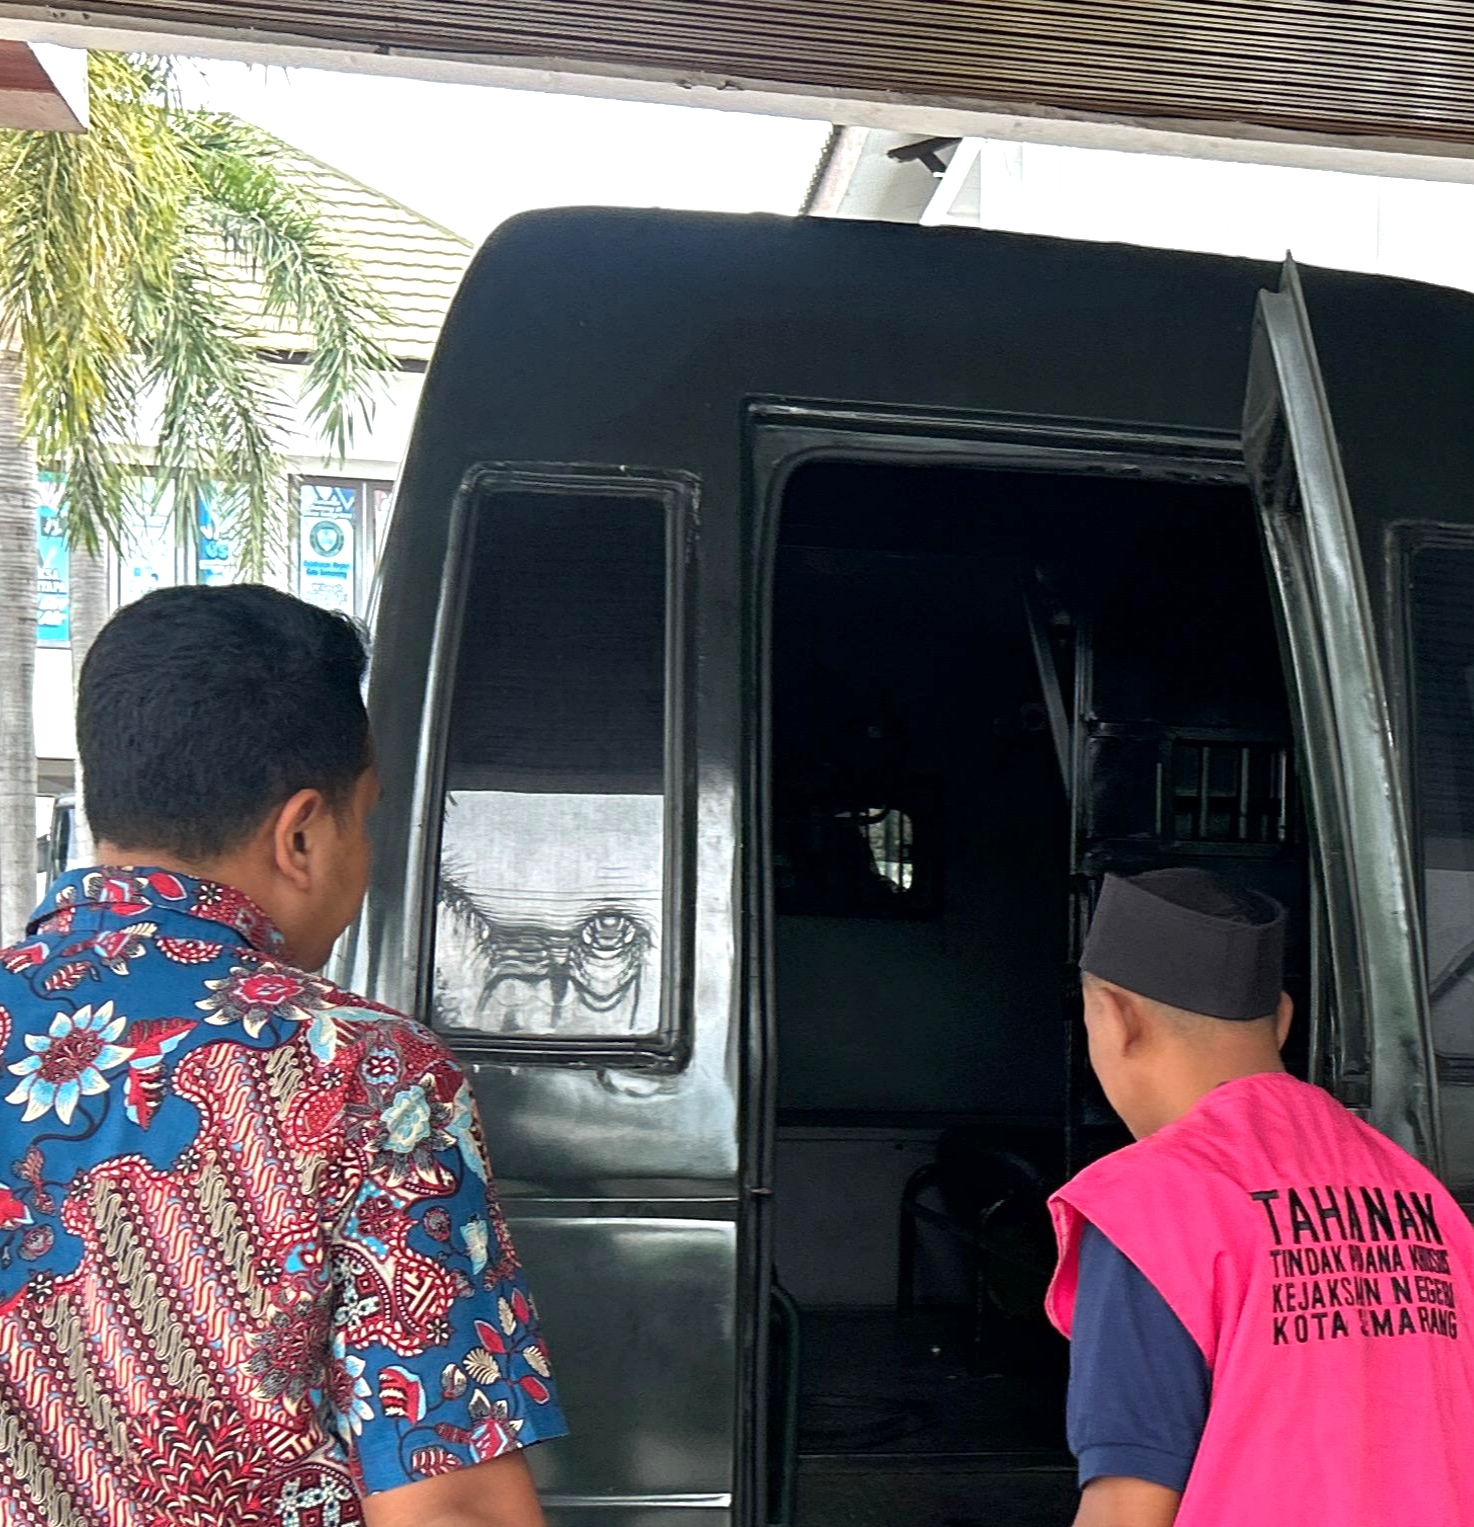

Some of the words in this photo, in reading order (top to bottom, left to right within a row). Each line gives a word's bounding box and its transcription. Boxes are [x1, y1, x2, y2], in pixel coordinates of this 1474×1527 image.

[1251, 1185, 1443, 1245] TAHANAN
[1270, 1245, 1346, 1278] TINDAK
[1273, 1310, 1349, 1345] KOTA
